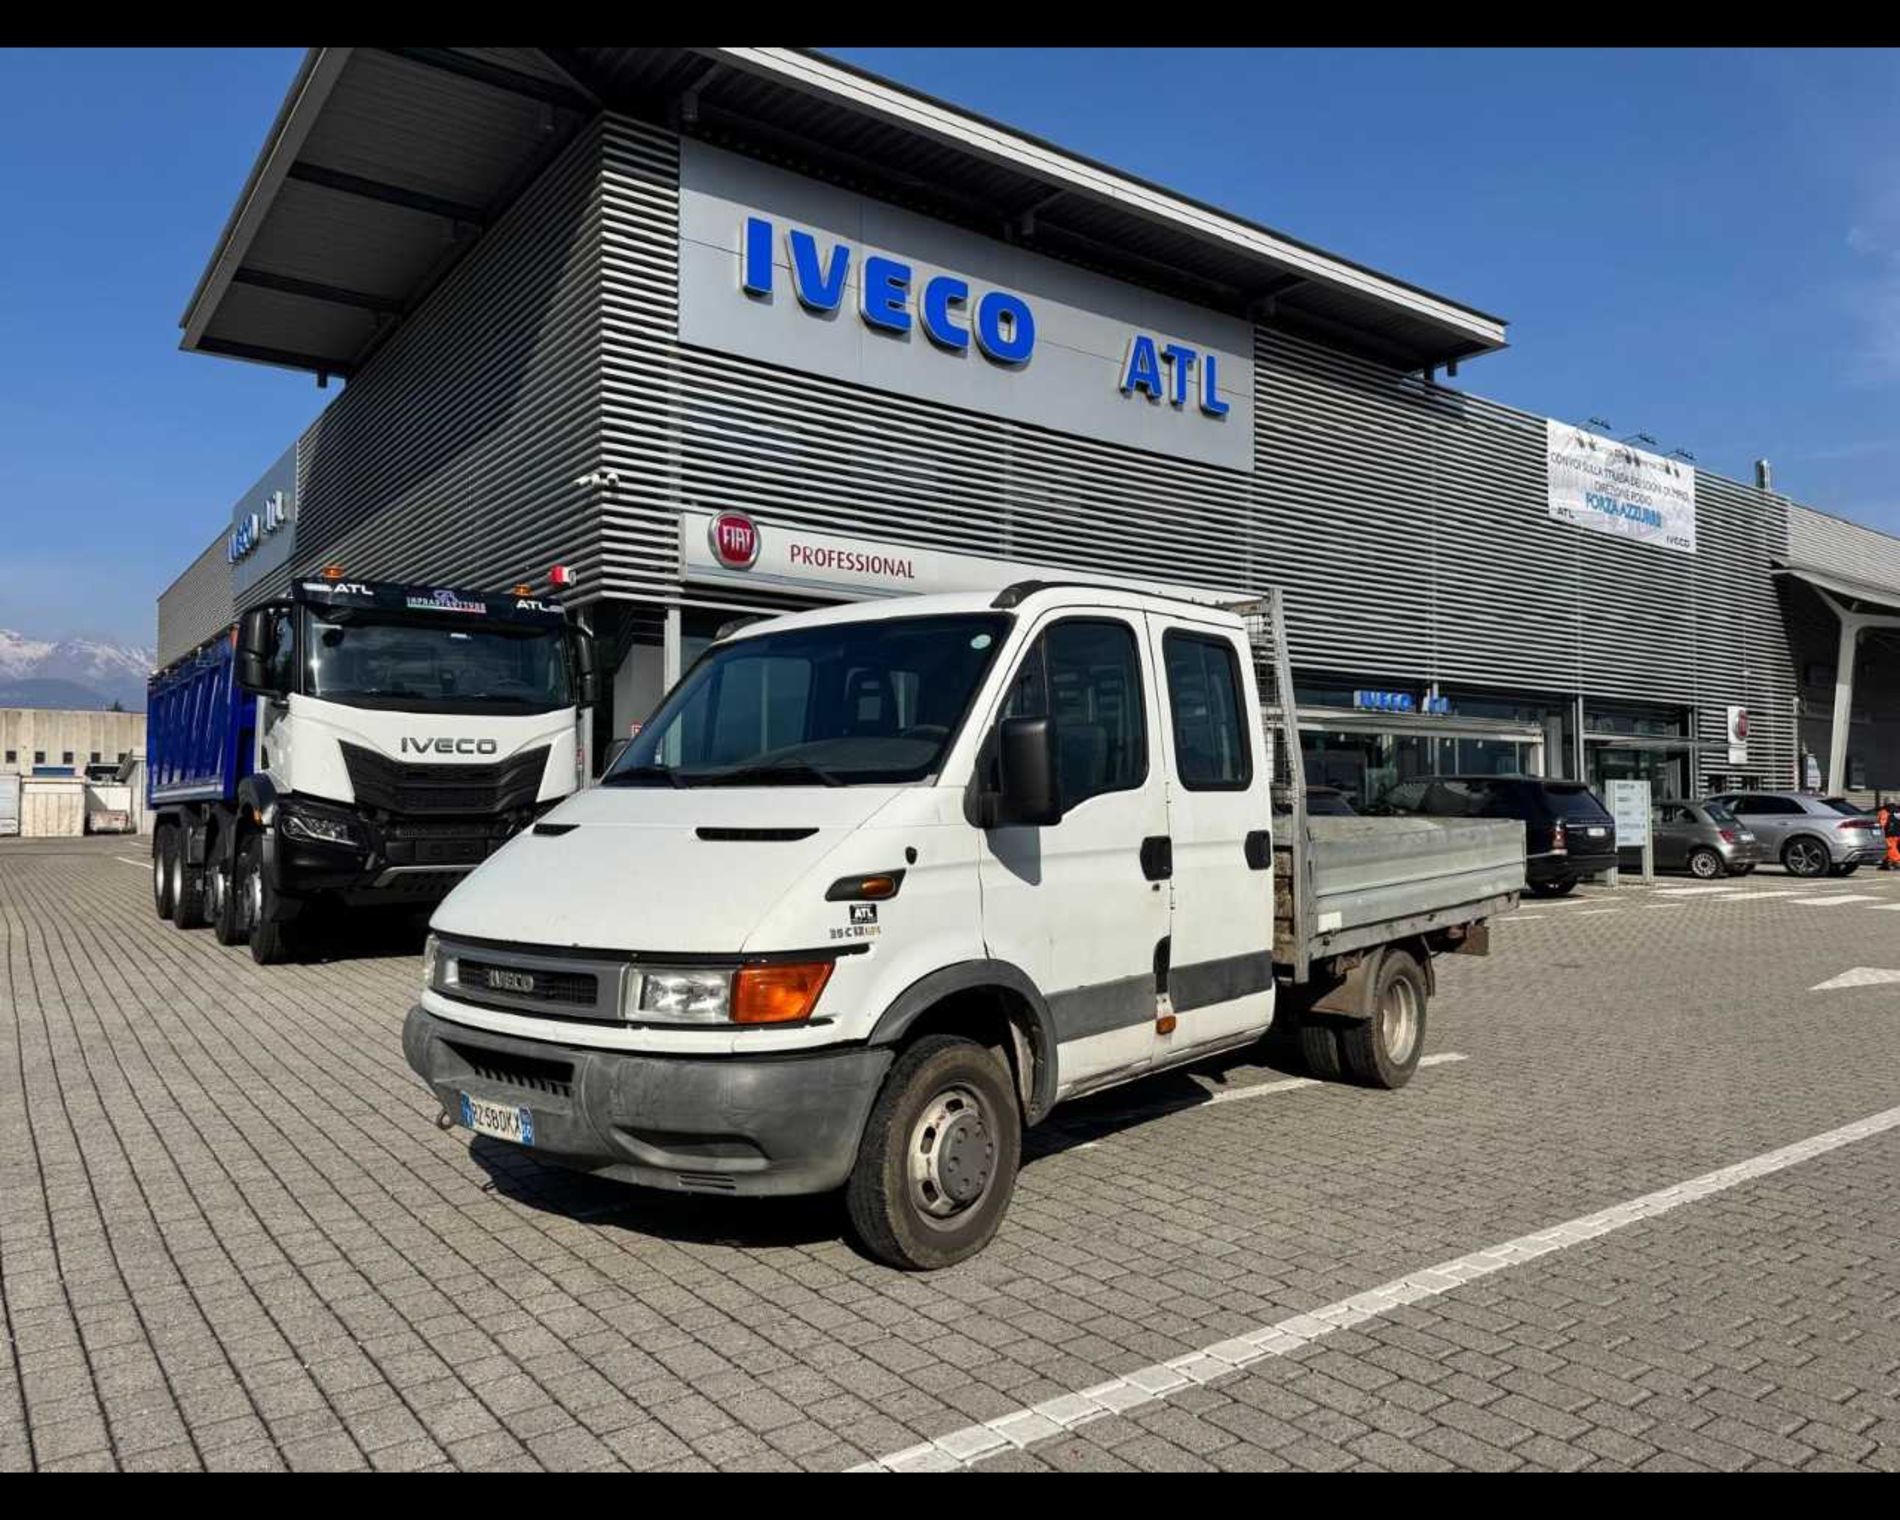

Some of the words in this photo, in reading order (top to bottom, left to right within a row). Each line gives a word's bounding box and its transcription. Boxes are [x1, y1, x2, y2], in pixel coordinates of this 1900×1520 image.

[742, 217, 1035, 365] IVECO
[1119, 334, 1230, 416] ATL
[722, 525, 752, 551] FIAT
[790, 544, 915, 579] PROFESSIONAL
[333, 583, 374, 596] ATL
[516, 599, 550, 612] ATL
[401, 737, 497, 754] IVECO
[854, 907, 873, 920] ATL
